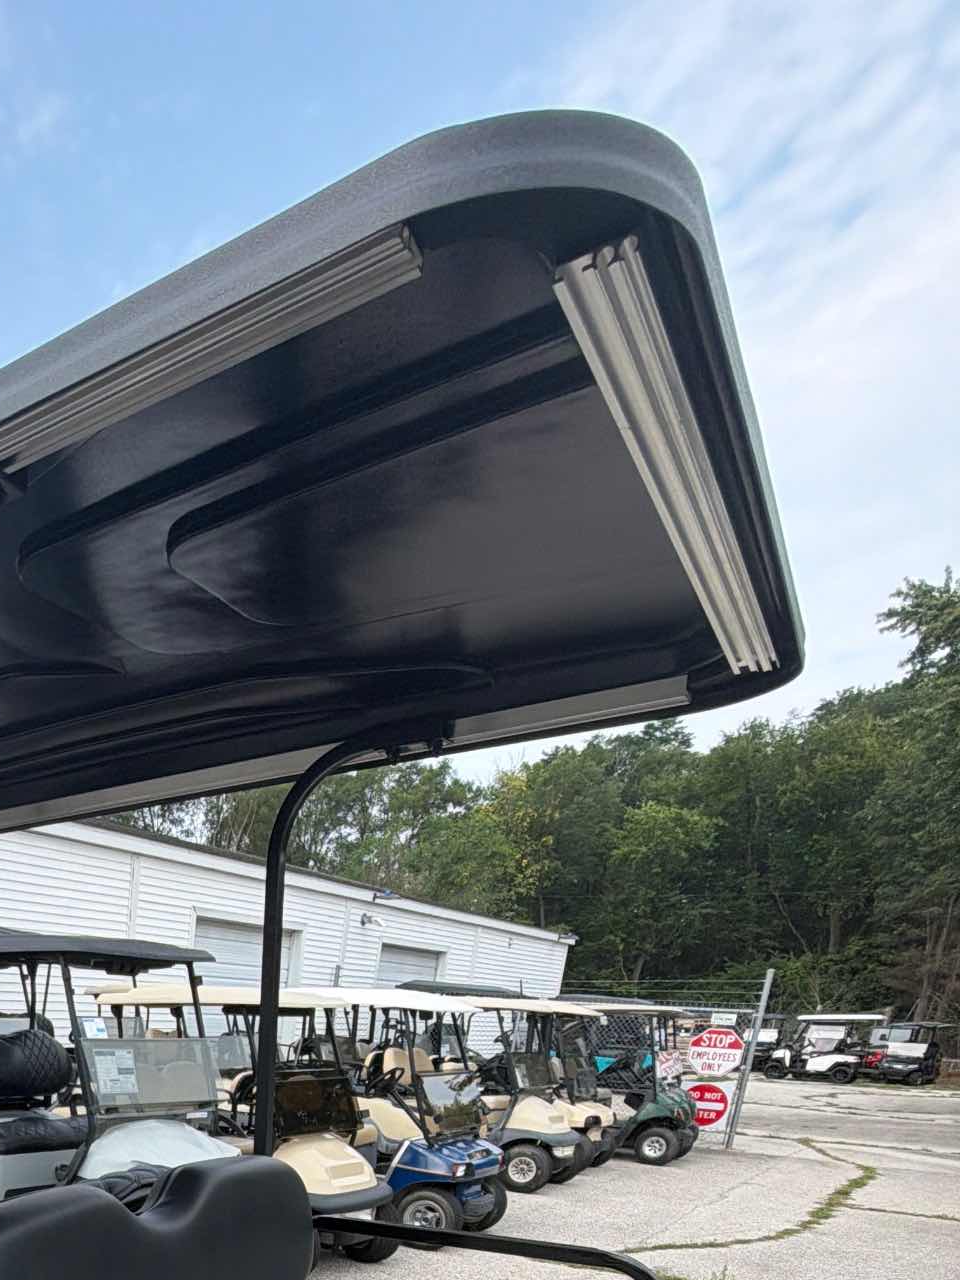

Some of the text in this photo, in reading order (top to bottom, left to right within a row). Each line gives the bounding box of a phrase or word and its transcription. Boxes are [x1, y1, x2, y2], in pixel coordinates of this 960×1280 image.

[700, 1034, 735, 1047] STOP
[691, 1050, 737, 1062] EMPLOYEES
[701, 1062, 721, 1072] ONLY
